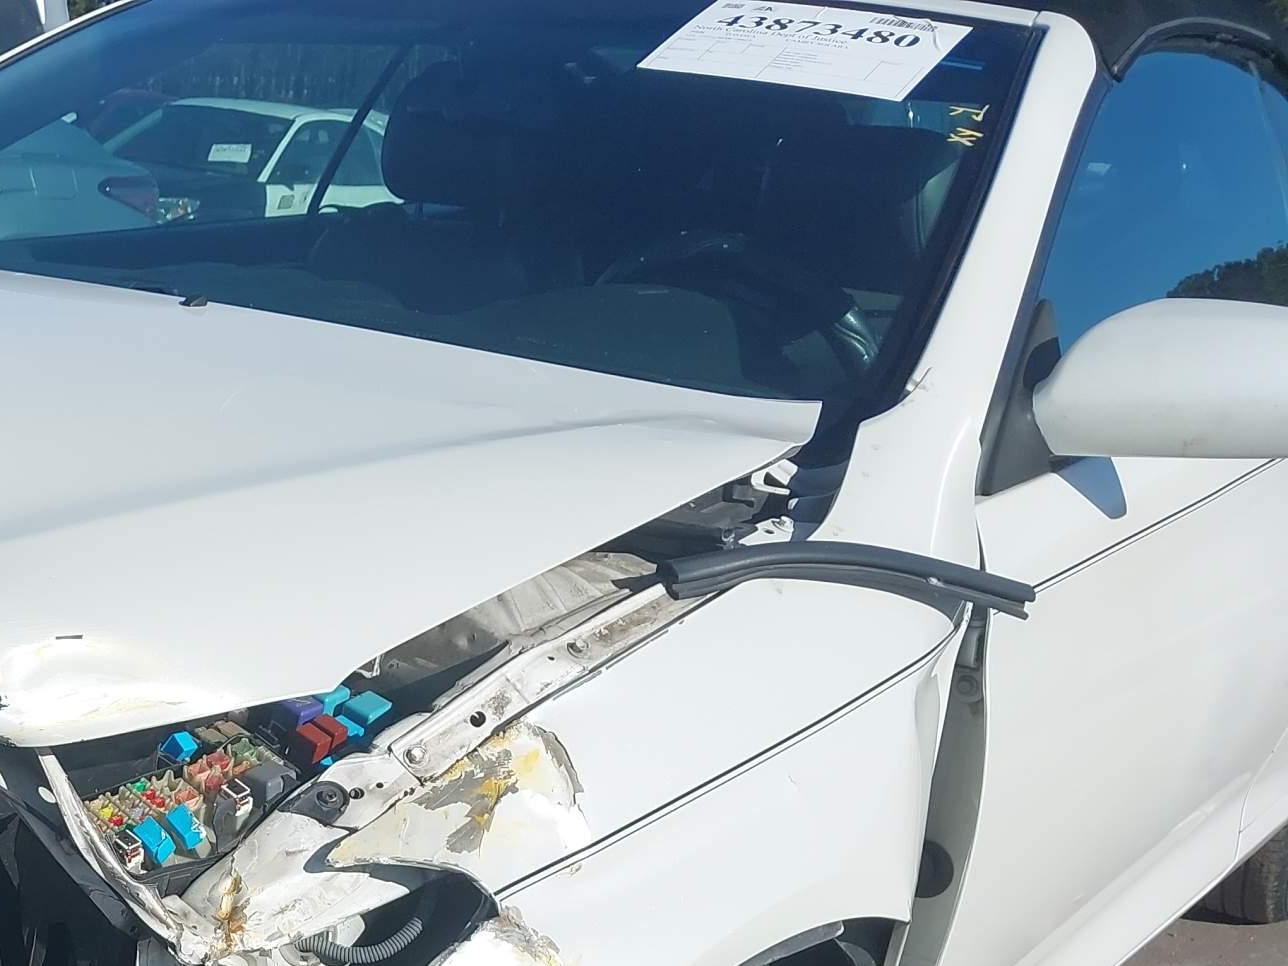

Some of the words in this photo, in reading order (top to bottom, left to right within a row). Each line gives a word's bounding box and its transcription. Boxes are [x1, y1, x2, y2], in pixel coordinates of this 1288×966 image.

[694, 24, 723, 32] North
[725, 27, 768, 36] Carolina
[770, 31, 795, 40] Dept
[812, 35, 848, 44] Justice
[717, 14, 921, 48] 43873480
